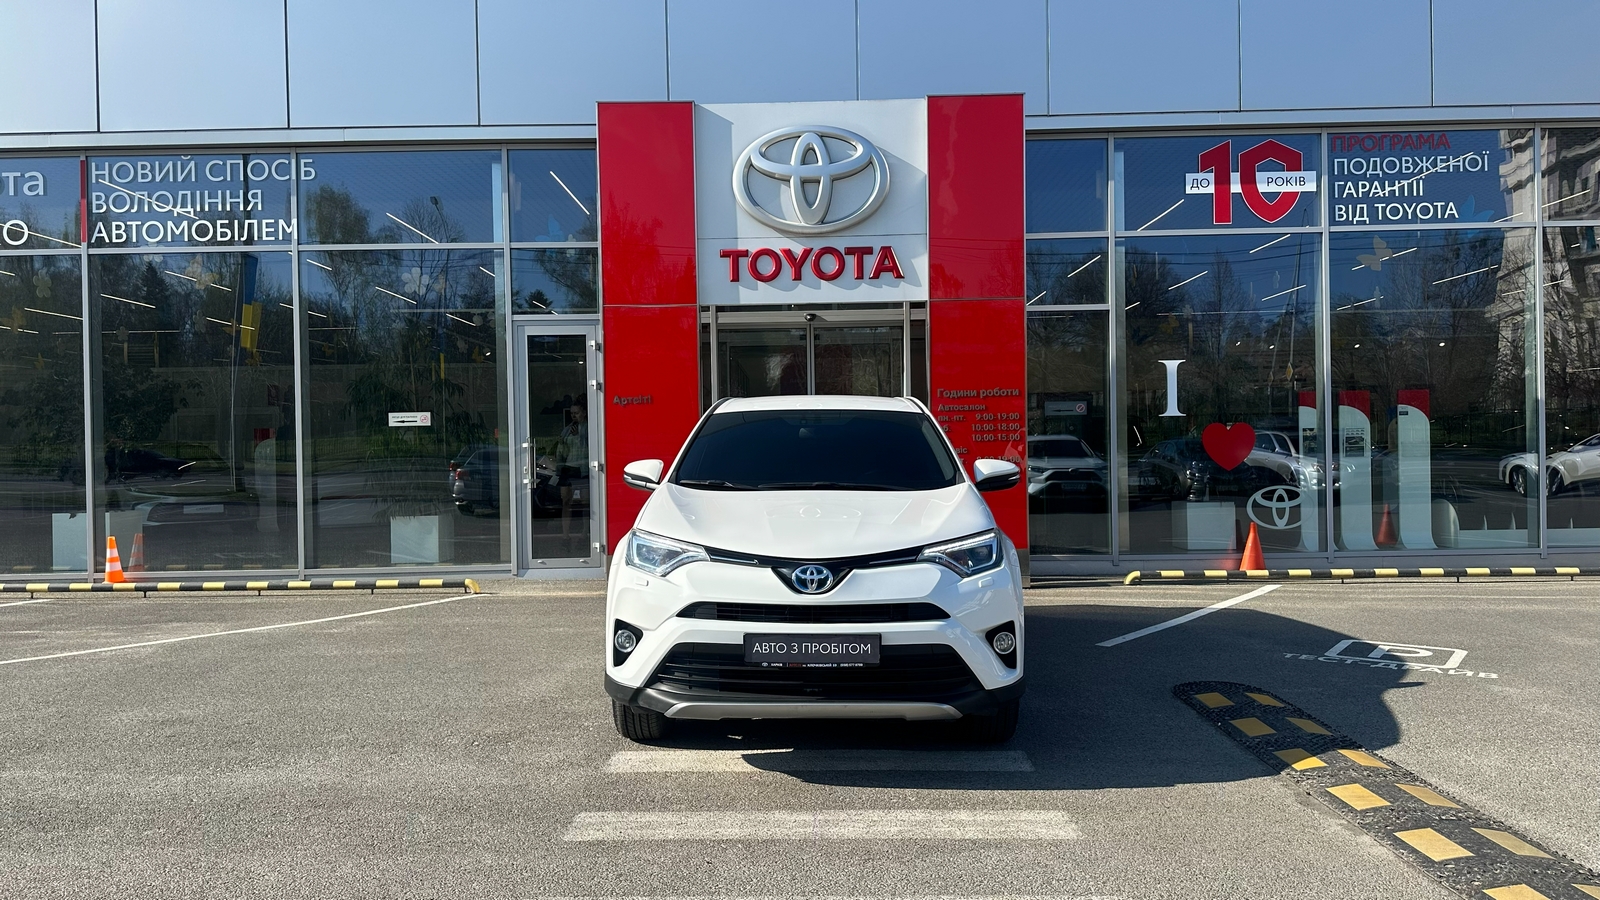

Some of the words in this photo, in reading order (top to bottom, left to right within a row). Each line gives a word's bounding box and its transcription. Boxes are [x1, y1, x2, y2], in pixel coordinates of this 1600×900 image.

[1331, 133, 1451, 152] ПРОГРАМА
[91, 155, 199, 184] НОВИЙ
[205, 158, 316, 182] СПОСІБ
[1333, 151, 1490, 177] ПОДОВЖЕНОЇ
[1190, 178, 1210, 190] ДО
[1199, 139, 1303, 224] 10
[1266, 175, 1306, 187] РОКІВ
[1334, 176, 1424, 198] ГАРАНТІЇ
[91, 189, 262, 217] ВОЛОДІННЯ
[1335, 204, 1370, 224] ВІД
[1374, 201, 1459, 221] TOYOTA
[0, 219, 29, 246] О
[91, 218, 298, 243] АВТОМОБІЛЕМ
[720, 246, 905, 282] TOYOTA
[937, 388, 977, 399] Години
[979, 387, 1019, 399] роботи
[1158, 359, 1186, 417] I
[938, 403, 986, 411] Автосалон
[941, 424, 952, 432] б.
[971, 423, 1020, 431] 10:00-18:00
[753, 642, 787, 653] АВТО
[802, 643, 871, 654] ПРОБІГОМ
